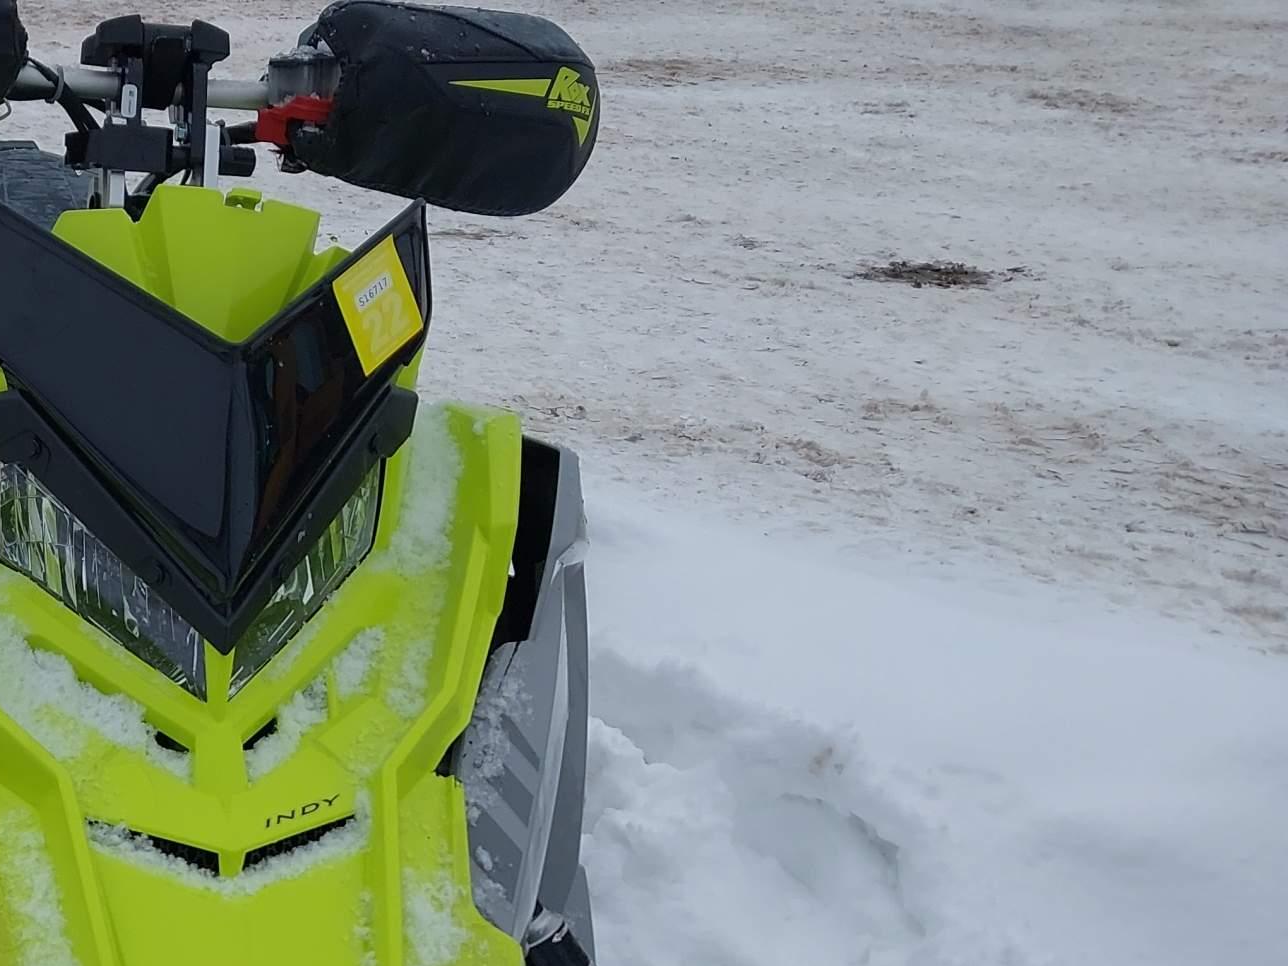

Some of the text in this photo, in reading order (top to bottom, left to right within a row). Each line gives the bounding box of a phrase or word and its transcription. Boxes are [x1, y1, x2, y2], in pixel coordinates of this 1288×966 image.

[547, 100, 582, 113] SPEED
[358, 277, 389, 307] S16717
[363, 292, 410, 353] 22
[266, 793, 340, 828] INDY
